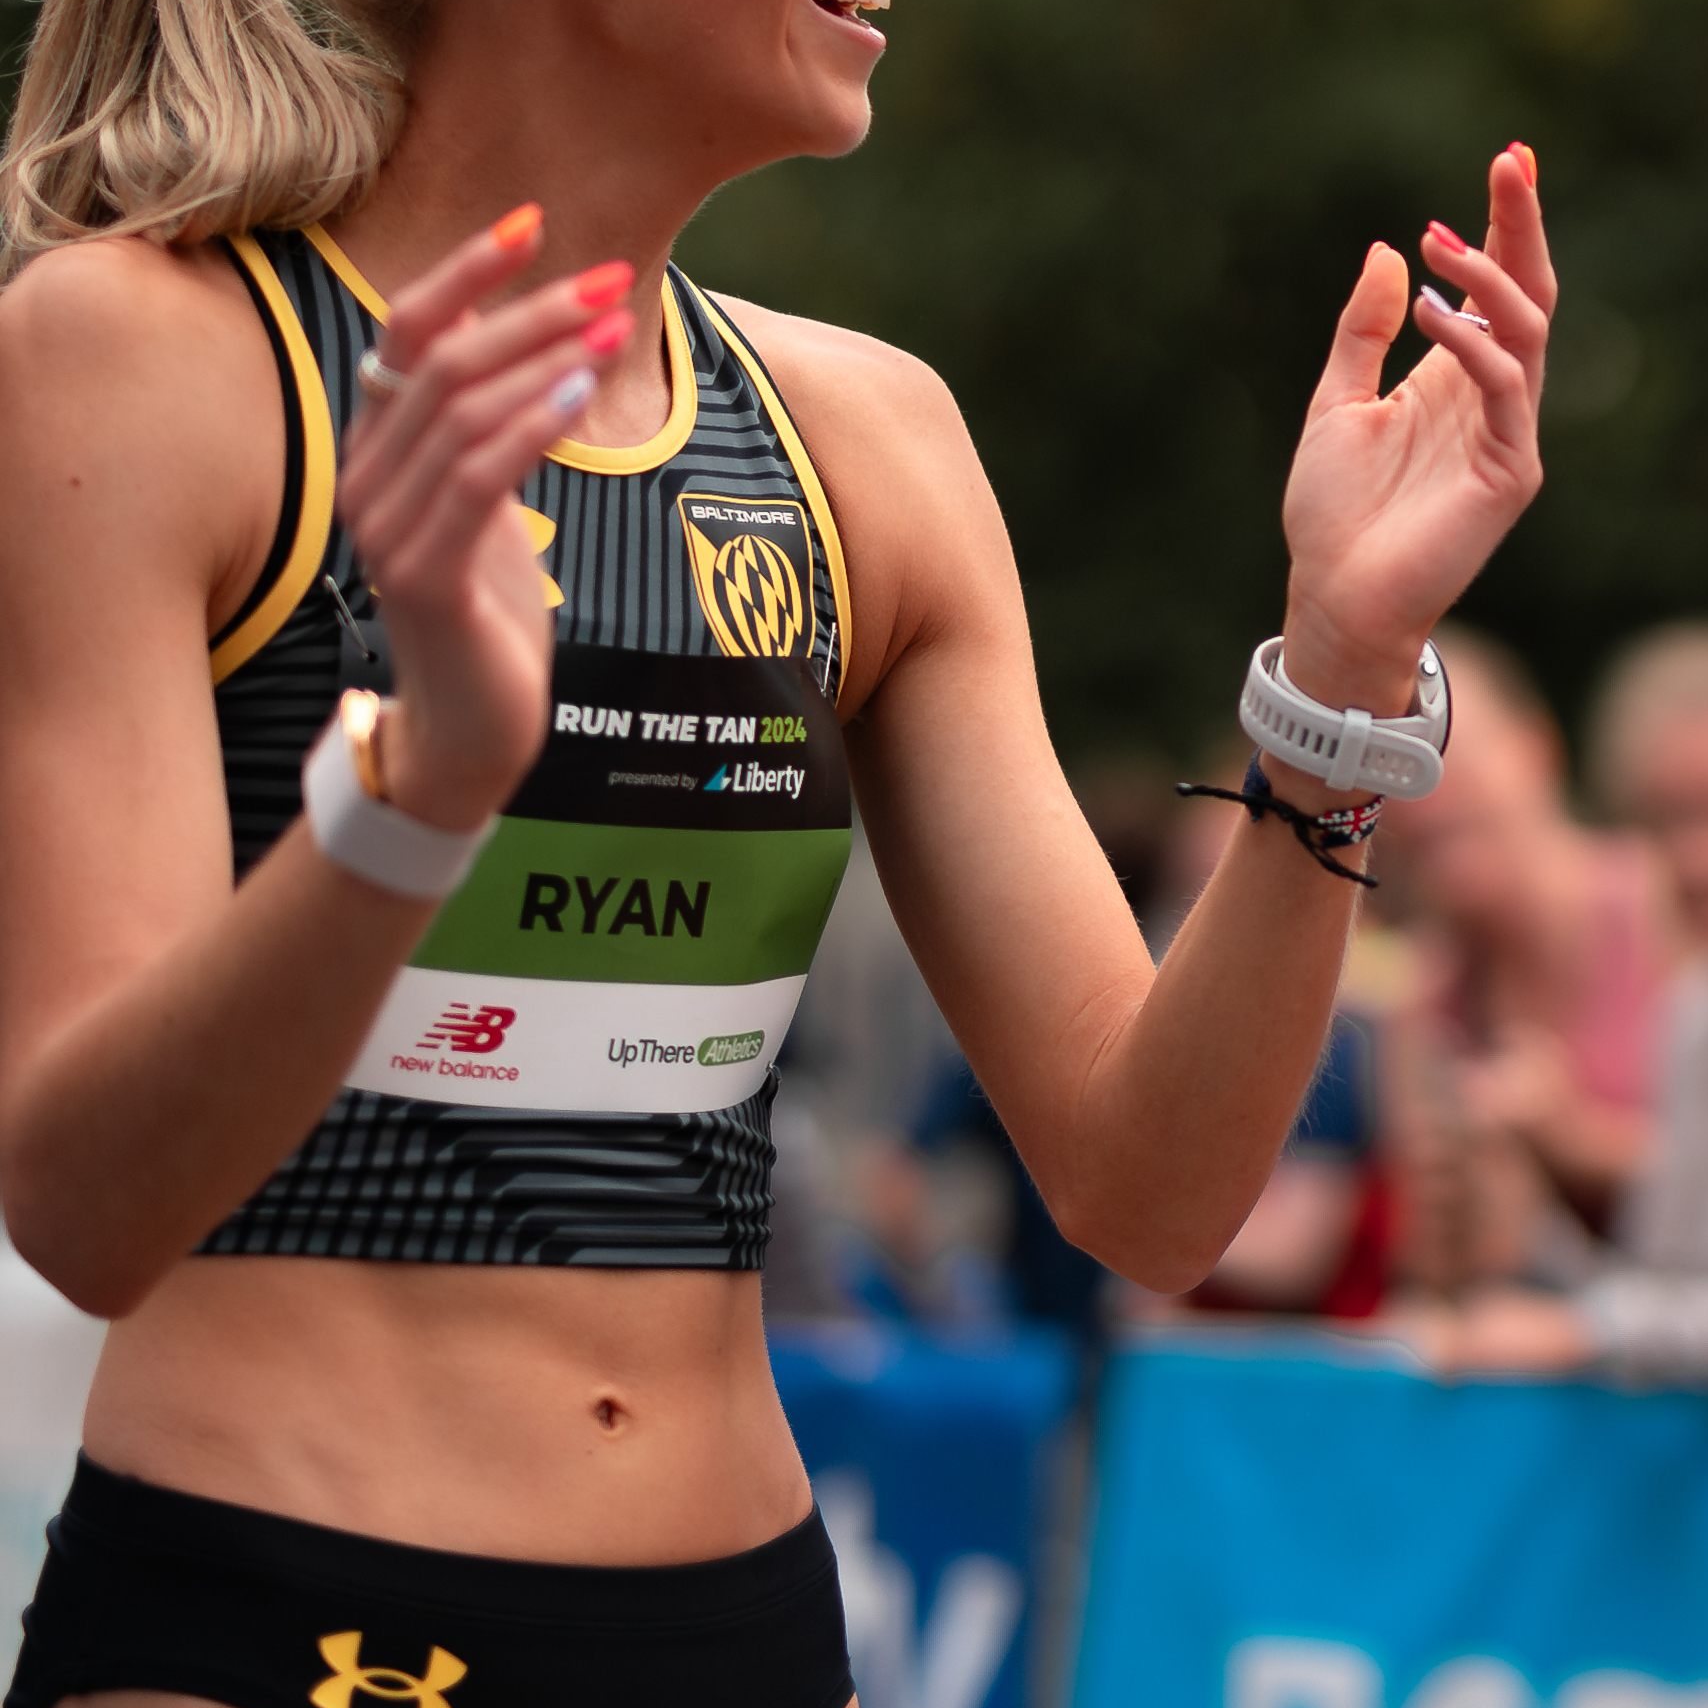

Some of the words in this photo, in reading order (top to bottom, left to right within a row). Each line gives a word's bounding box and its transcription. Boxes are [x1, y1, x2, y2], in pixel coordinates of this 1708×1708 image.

[690, 505, 796, 525] BALTIMORE
[555, 702, 633, 738] RUN
[640, 712, 699, 742] THE
[705, 716, 757, 743] TAN
[760, 716, 807, 743] 2024
[608, 771, 680, 787] presented
[681, 773, 698, 790] by
[733, 762, 805, 799] Liberty
[518, 872, 711, 938] RYAN
[391, 1054, 434, 1072] new
[439, 1059, 520, 1081] balance
[608, 1038, 695, 1068] UpThere
[701, 1035, 762, 1063] Athletics
